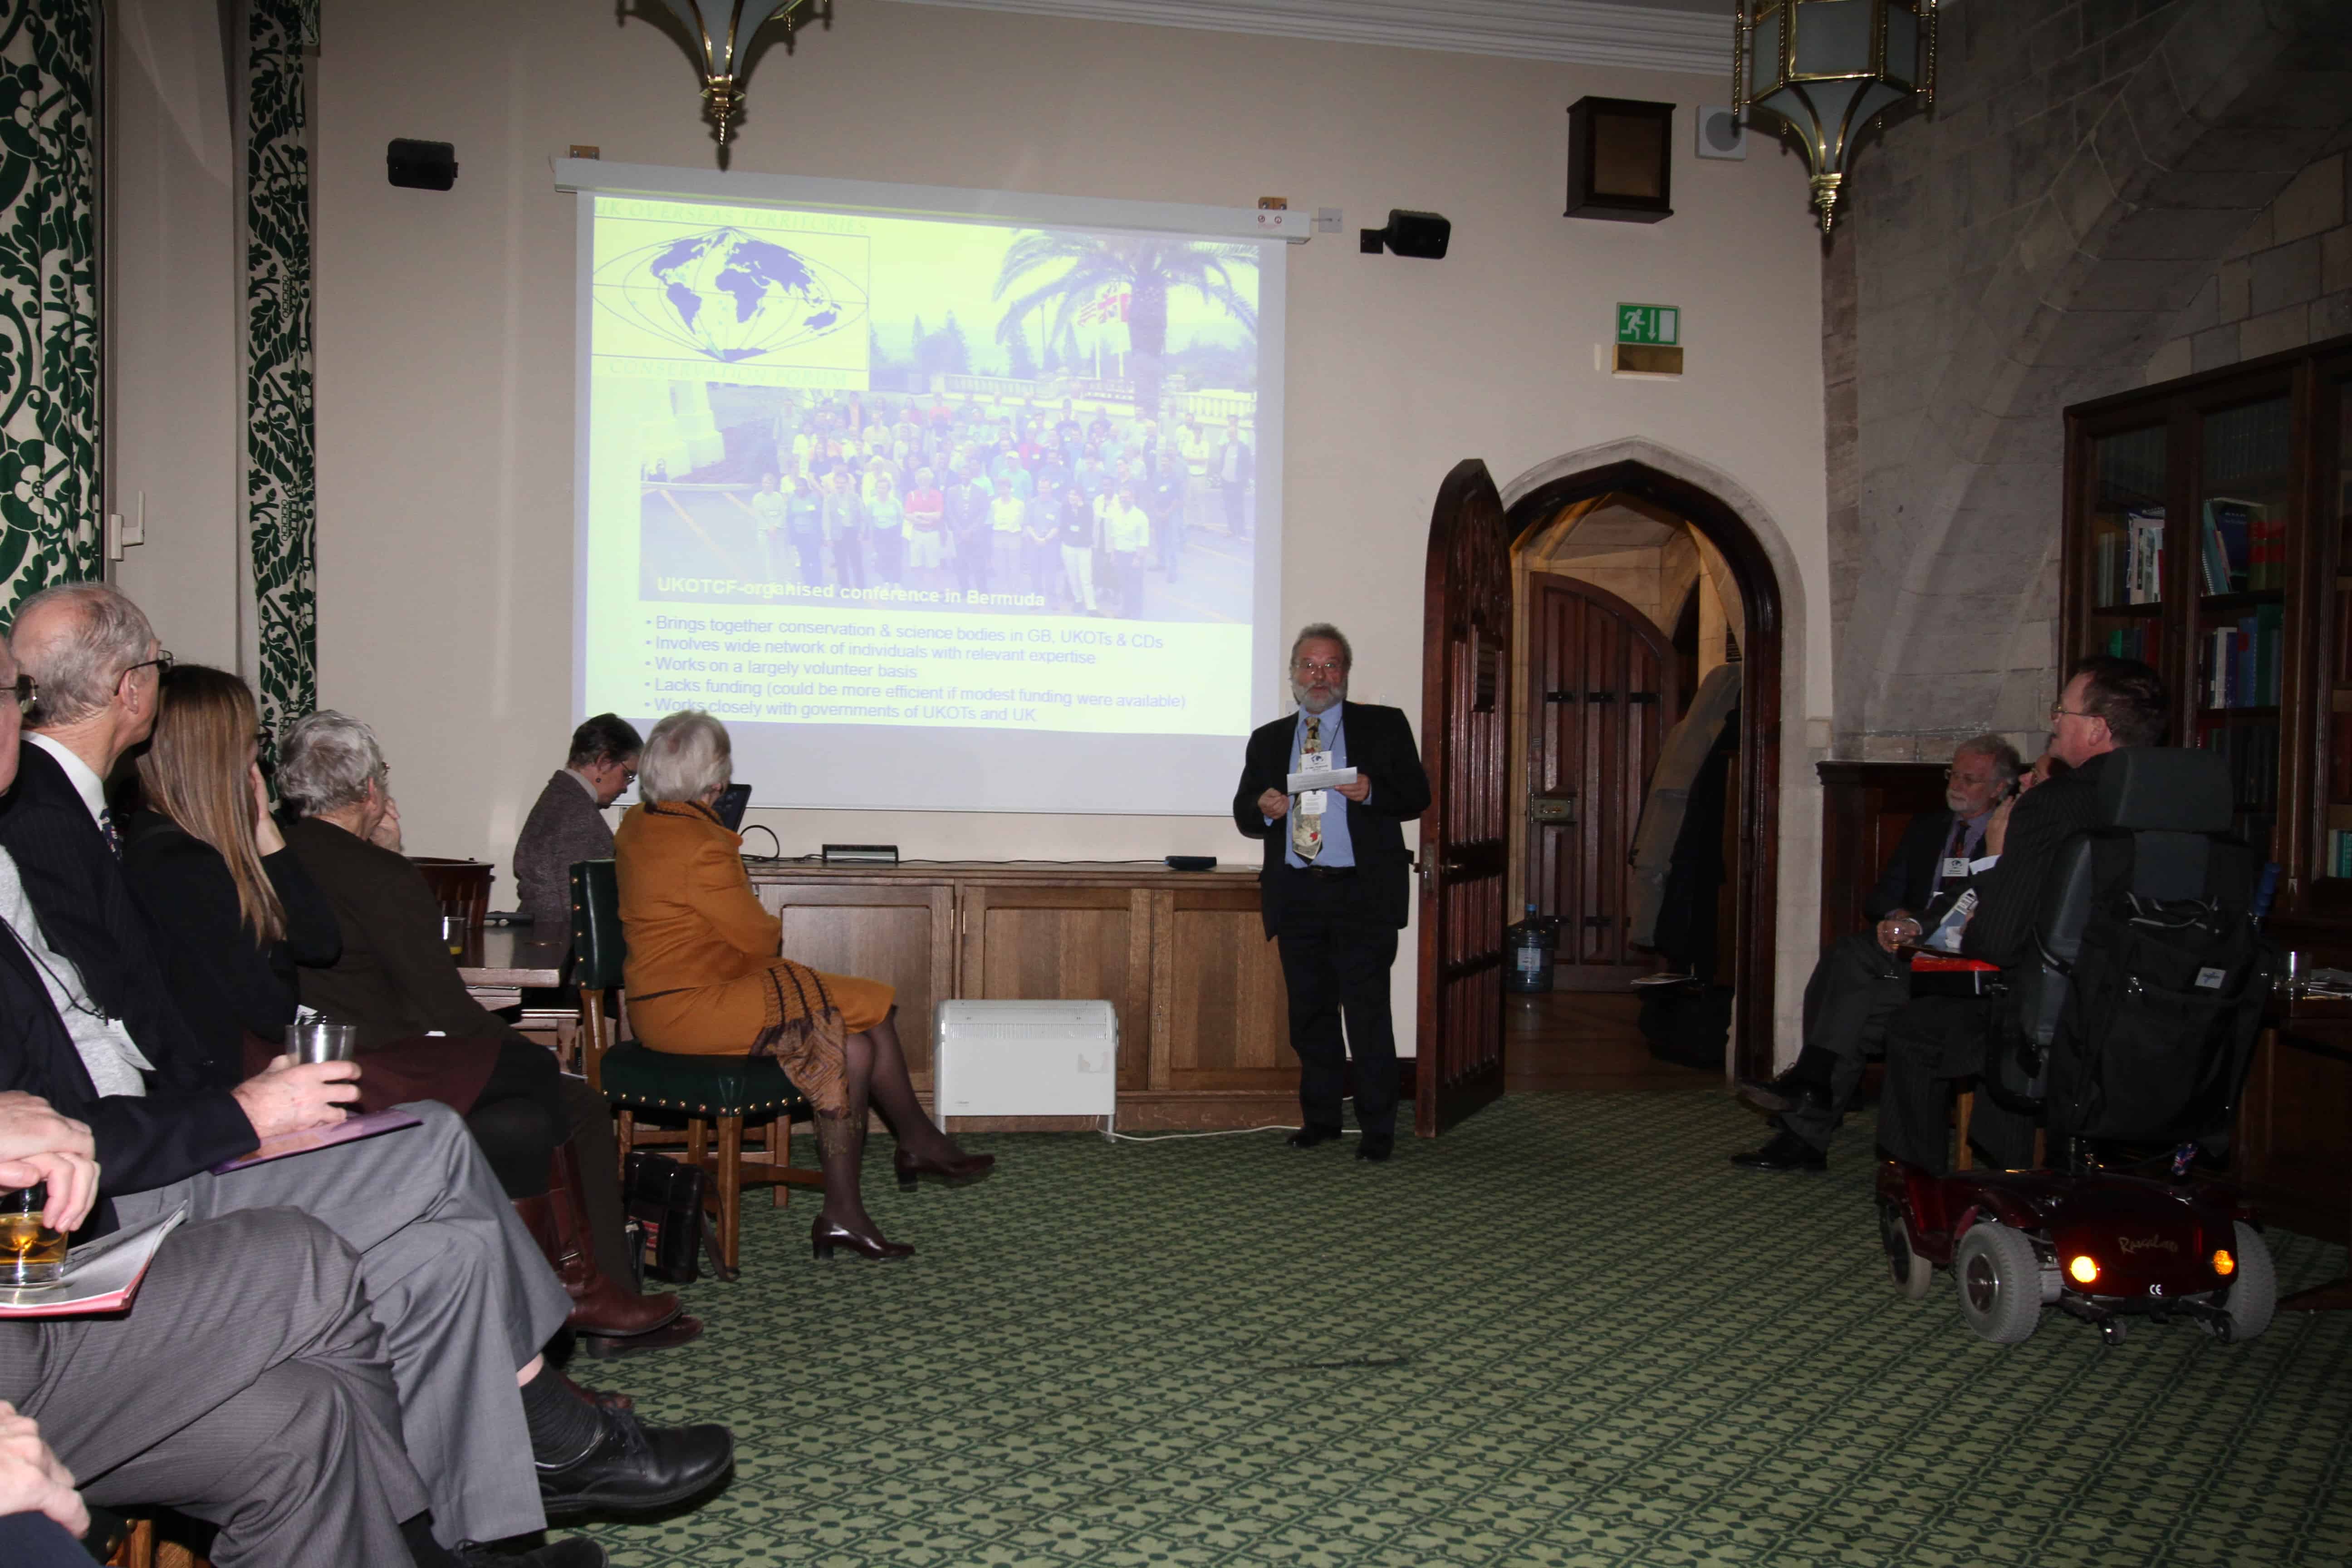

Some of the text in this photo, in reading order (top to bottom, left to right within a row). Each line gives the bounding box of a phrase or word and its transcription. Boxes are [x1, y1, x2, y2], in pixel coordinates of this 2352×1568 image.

[657, 576, 1045, 607] UKOTCF-organised conference in Bermuda
[657, 615, 1163, 648] Brings together conservation & science bodies in GB, UKOTs & CDs
[657, 636, 1096, 664] Involves wide network of individuals with relevant expertise
[655, 657, 917, 678] Works on a largely volunteer basis
[655, 677, 1186, 709] Lacks funding (could be more efficient if modest funding were available)
[655, 697, 1037, 722] Works closely with governments of UKOTs and UK
[2149, 1284, 2162, 1295] CE
